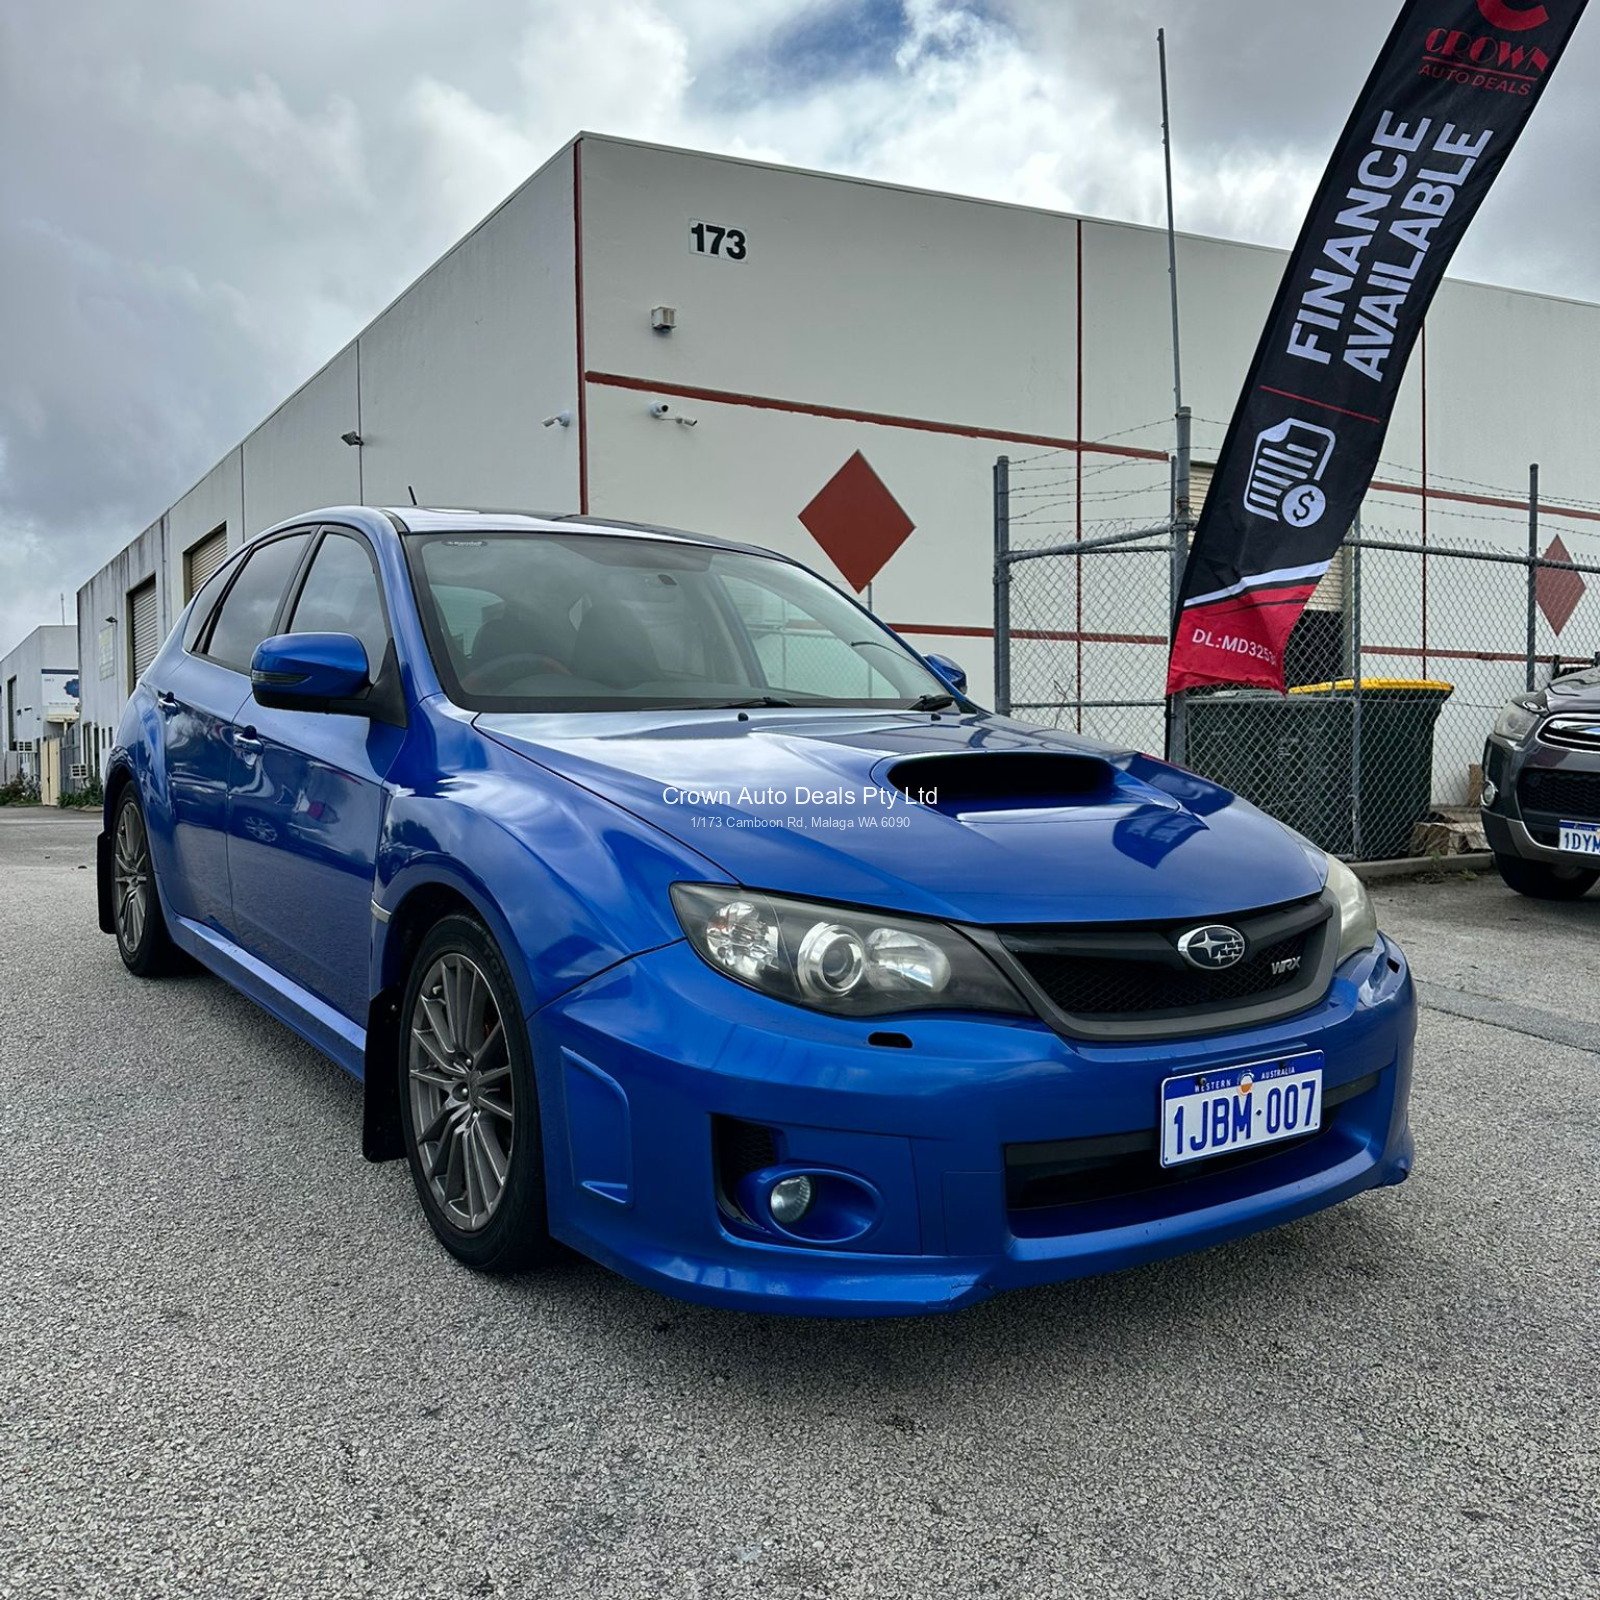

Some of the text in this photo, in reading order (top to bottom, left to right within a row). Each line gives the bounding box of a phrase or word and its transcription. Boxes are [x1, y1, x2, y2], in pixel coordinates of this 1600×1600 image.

[1425, 27, 1549, 72] CROWN
[1418, 63, 1532, 96] AUTO DEALS
[691, 222, 747, 260] 173
[1286, 110, 1432, 364] FINANCE
[1342, 123, 1494, 382] AVAILABLE
[1194, 1066, 1296, 1093] WESTERN AUSTRALIA
